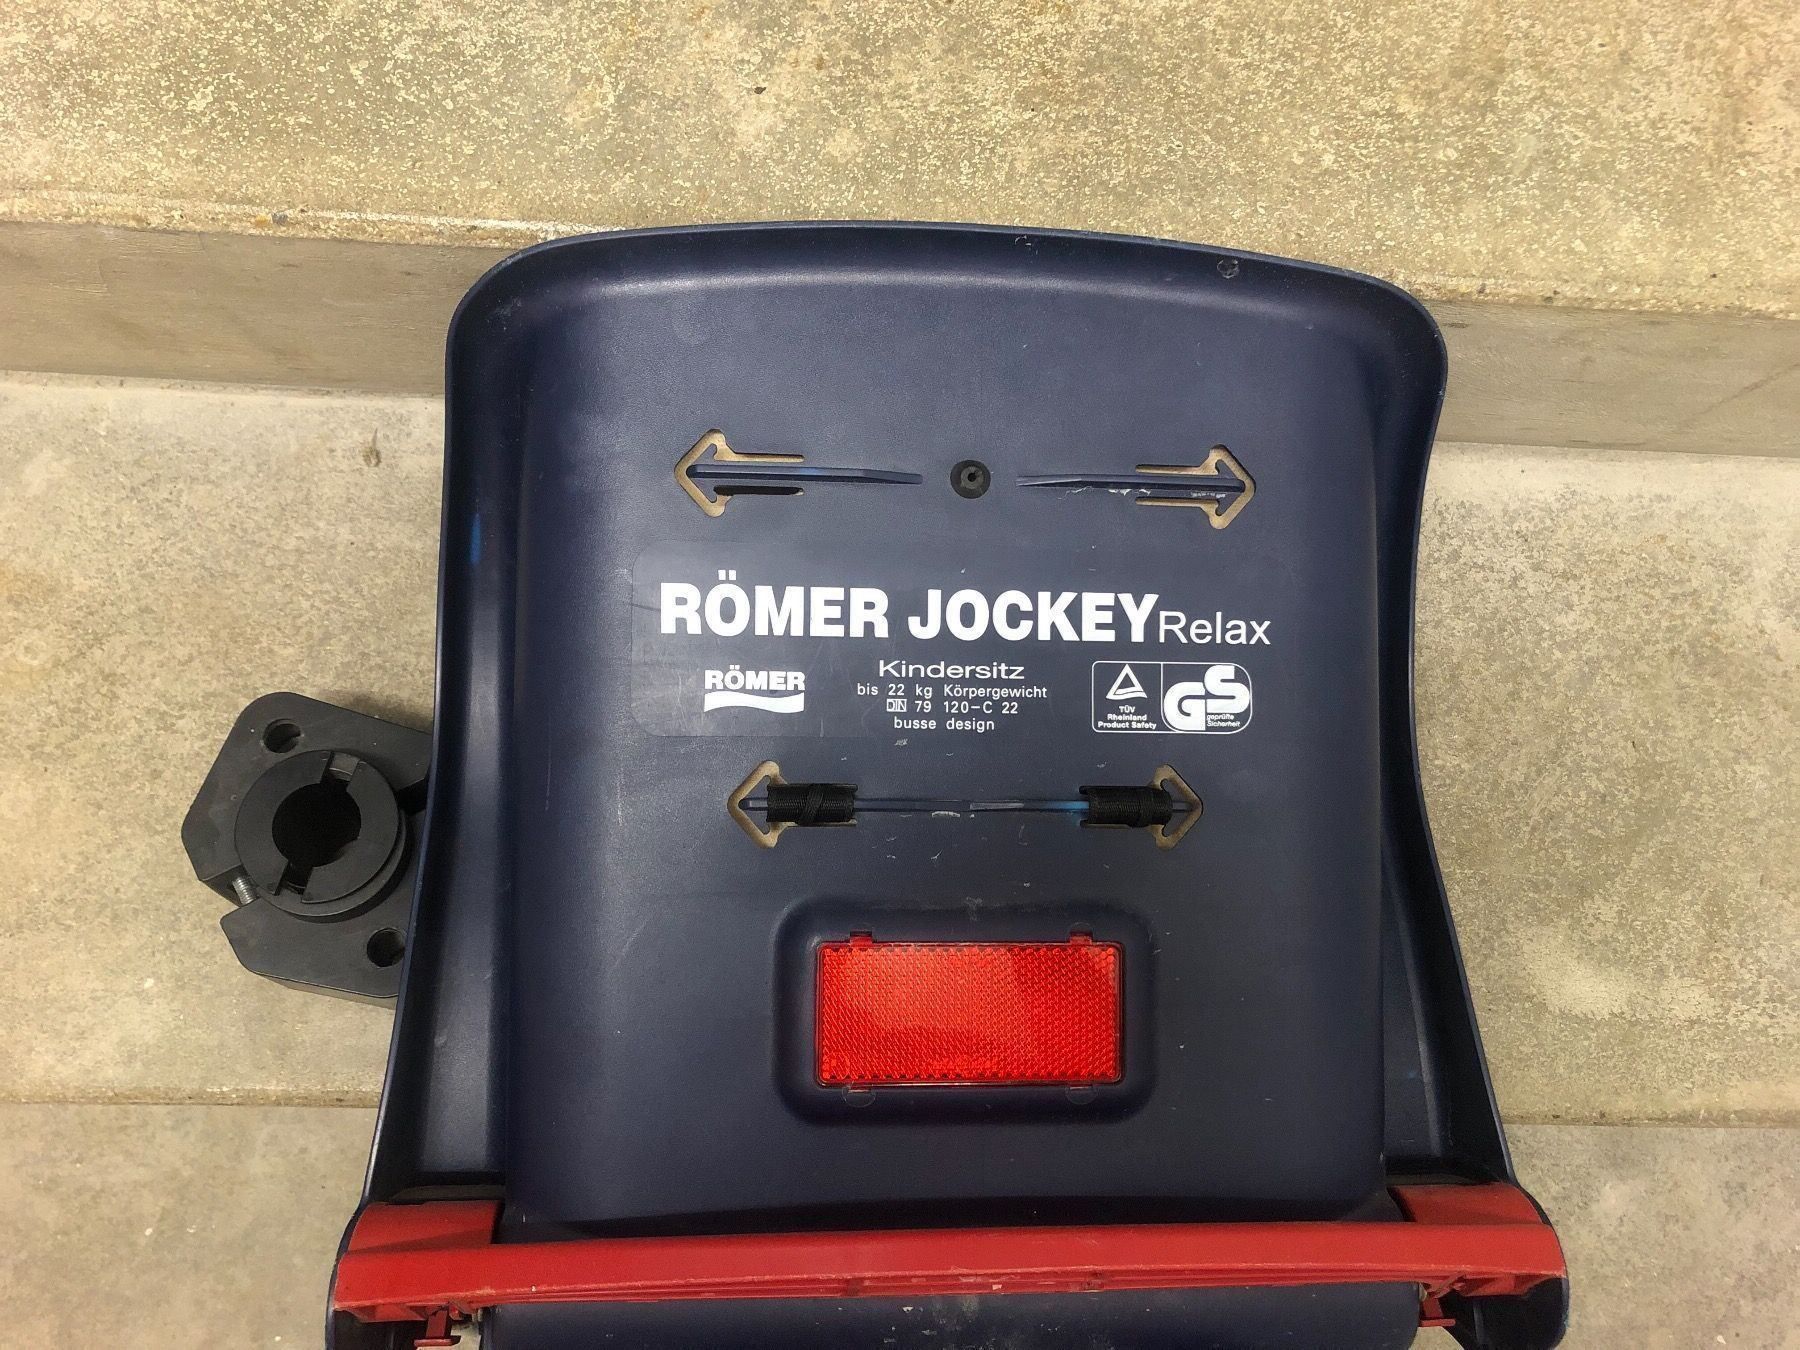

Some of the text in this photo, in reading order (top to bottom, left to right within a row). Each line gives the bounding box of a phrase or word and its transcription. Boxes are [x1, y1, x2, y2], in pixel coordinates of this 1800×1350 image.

[660, 569, 1271, 645] RÖMER JOCKEY Relax
[704, 664, 806, 691] RÖMER
[879, 659, 1025, 680] Kindersitz
[857, 683, 1048, 700] bis 22 kg Körpergewicht
[1163, 664, 1251, 731] GS
[886, 699, 908, 713] DIN
[914, 700, 932, 713] 79
[1001, 701, 1019, 714] 22
[1118, 704, 1136, 713] TÜV
[893, 716, 995, 733] busse design
[1097, 721, 1157, 730] Product Safety
[1107, 713, 1148, 721] Rheinland
